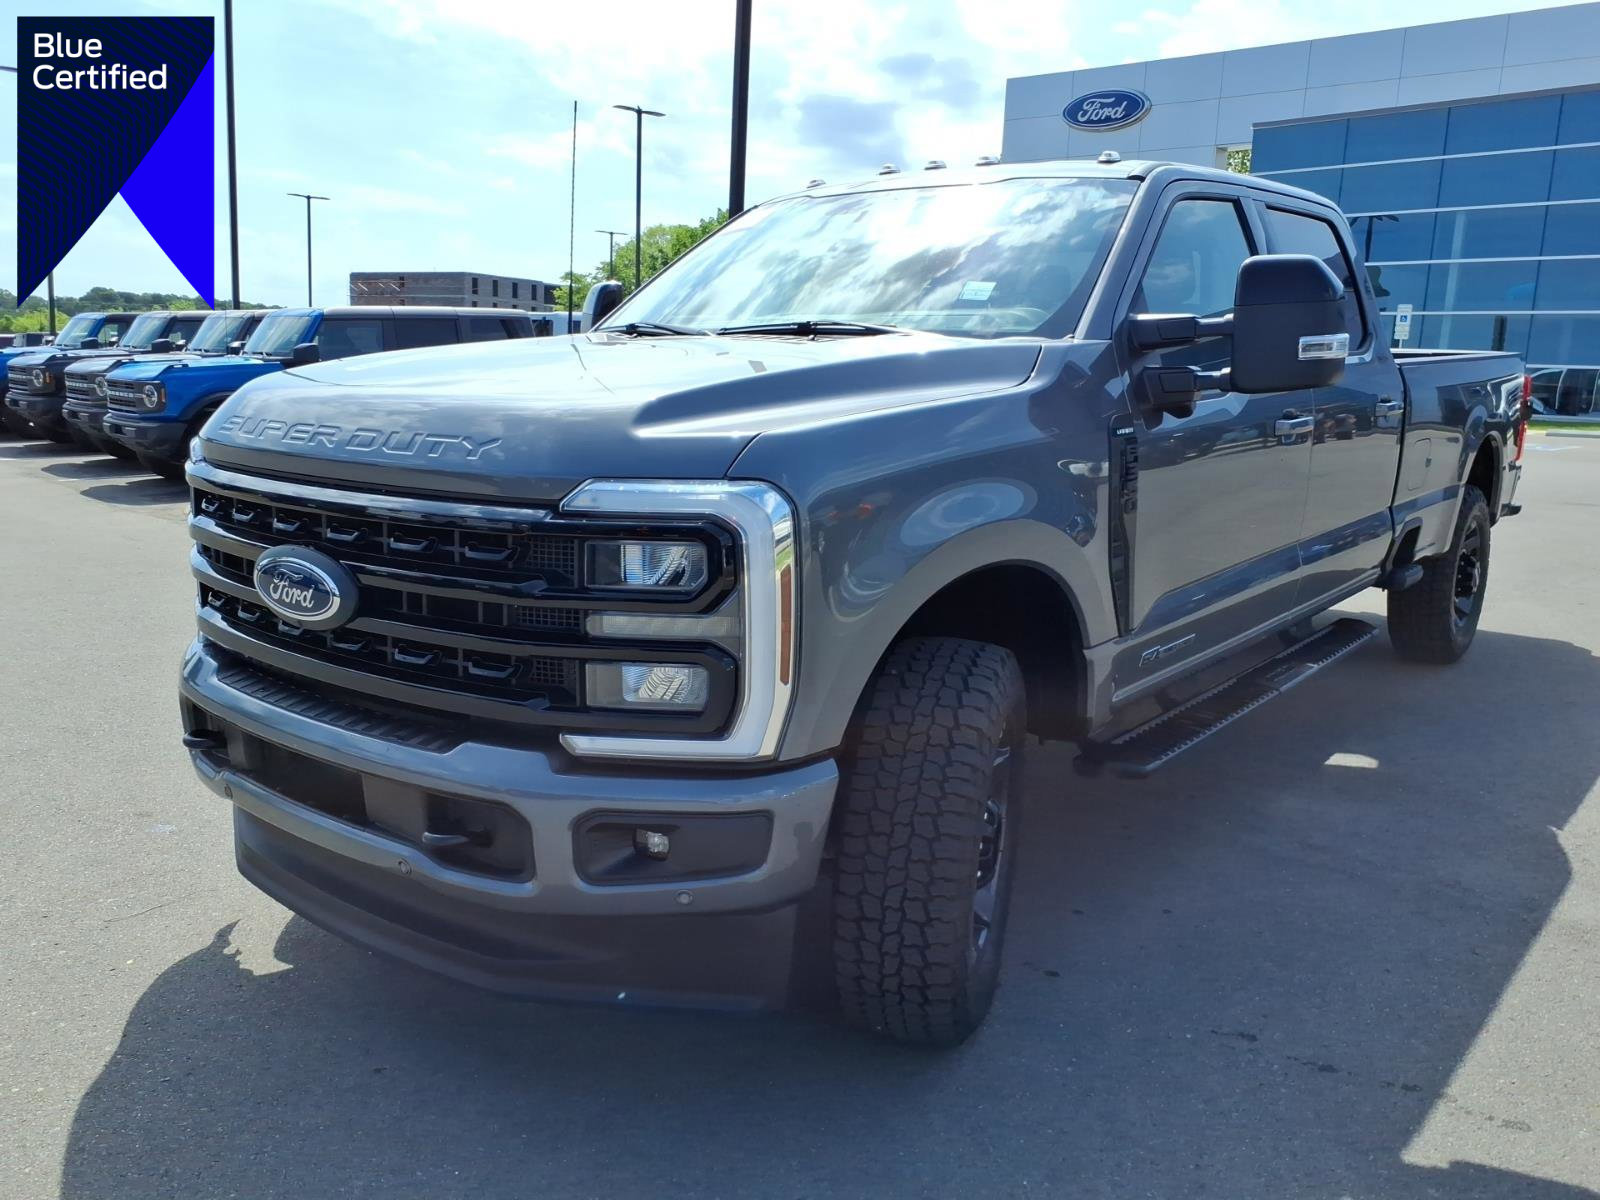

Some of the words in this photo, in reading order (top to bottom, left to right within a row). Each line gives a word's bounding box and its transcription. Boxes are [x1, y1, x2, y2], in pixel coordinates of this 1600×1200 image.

[1077, 97, 1127, 122] Ford
[219, 415, 342, 448] SUPER
[345, 428, 502, 460] DUTY
[269, 568, 315, 609] Ford
